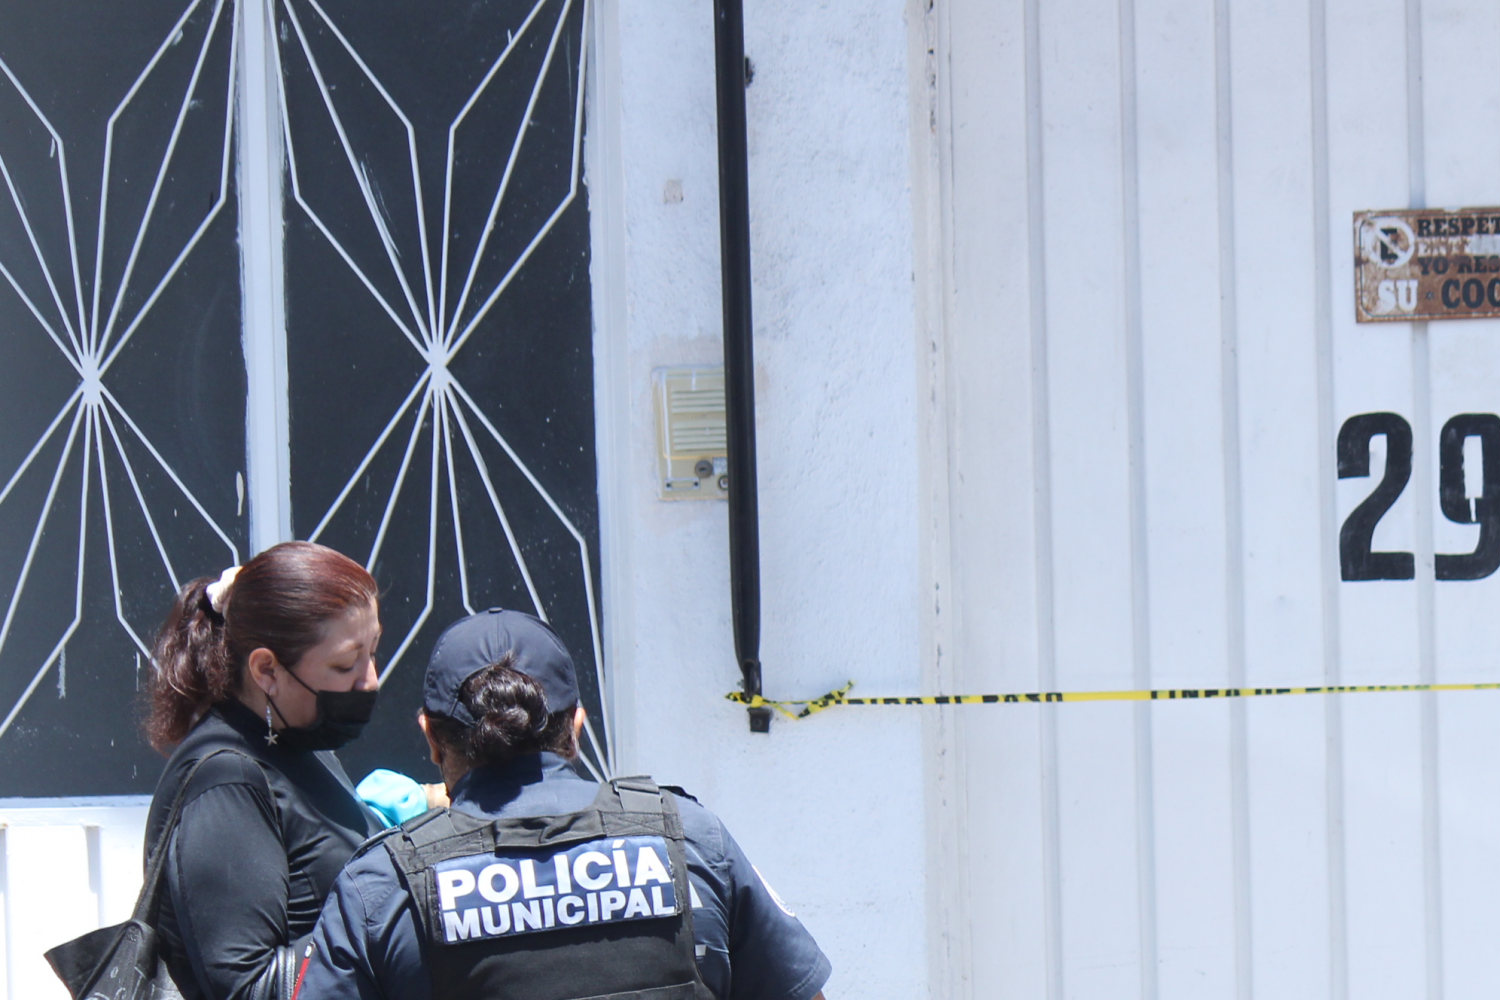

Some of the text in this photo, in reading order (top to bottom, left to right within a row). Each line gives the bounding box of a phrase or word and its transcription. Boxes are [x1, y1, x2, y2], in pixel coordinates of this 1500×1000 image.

[1417, 256, 1449, 275] YO
[1378, 280, 1418, 314] SU
[437, 840, 672, 911] POLICÍA
[443, 886, 675, 942] MUNICIPAL
